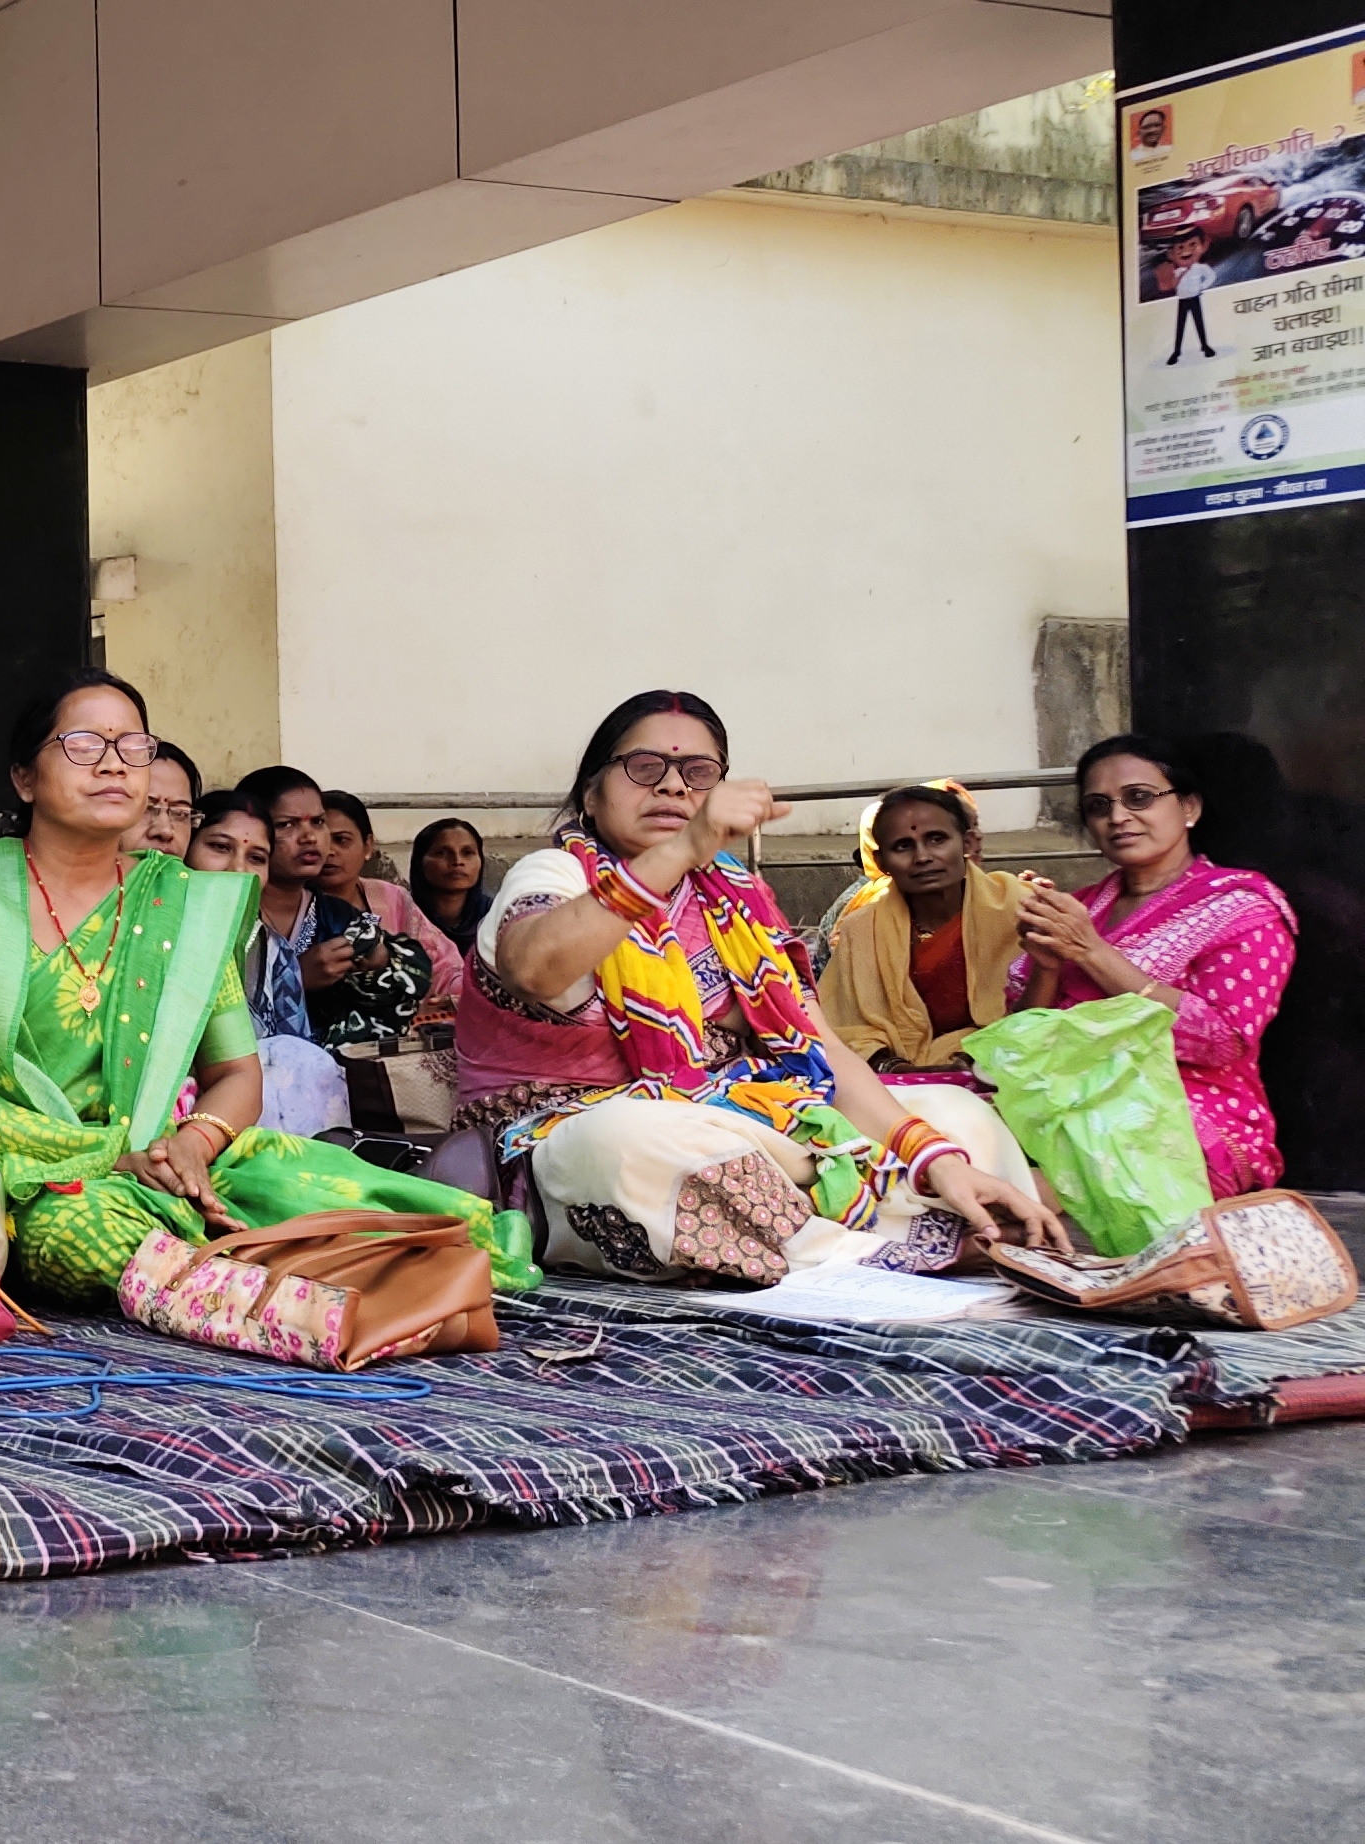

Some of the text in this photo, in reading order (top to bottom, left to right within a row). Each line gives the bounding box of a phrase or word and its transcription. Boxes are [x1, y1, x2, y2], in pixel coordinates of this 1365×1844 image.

[1233, 274, 1363, 314] वाहन गति सीमा
[1251, 341, 1286, 361] जान
